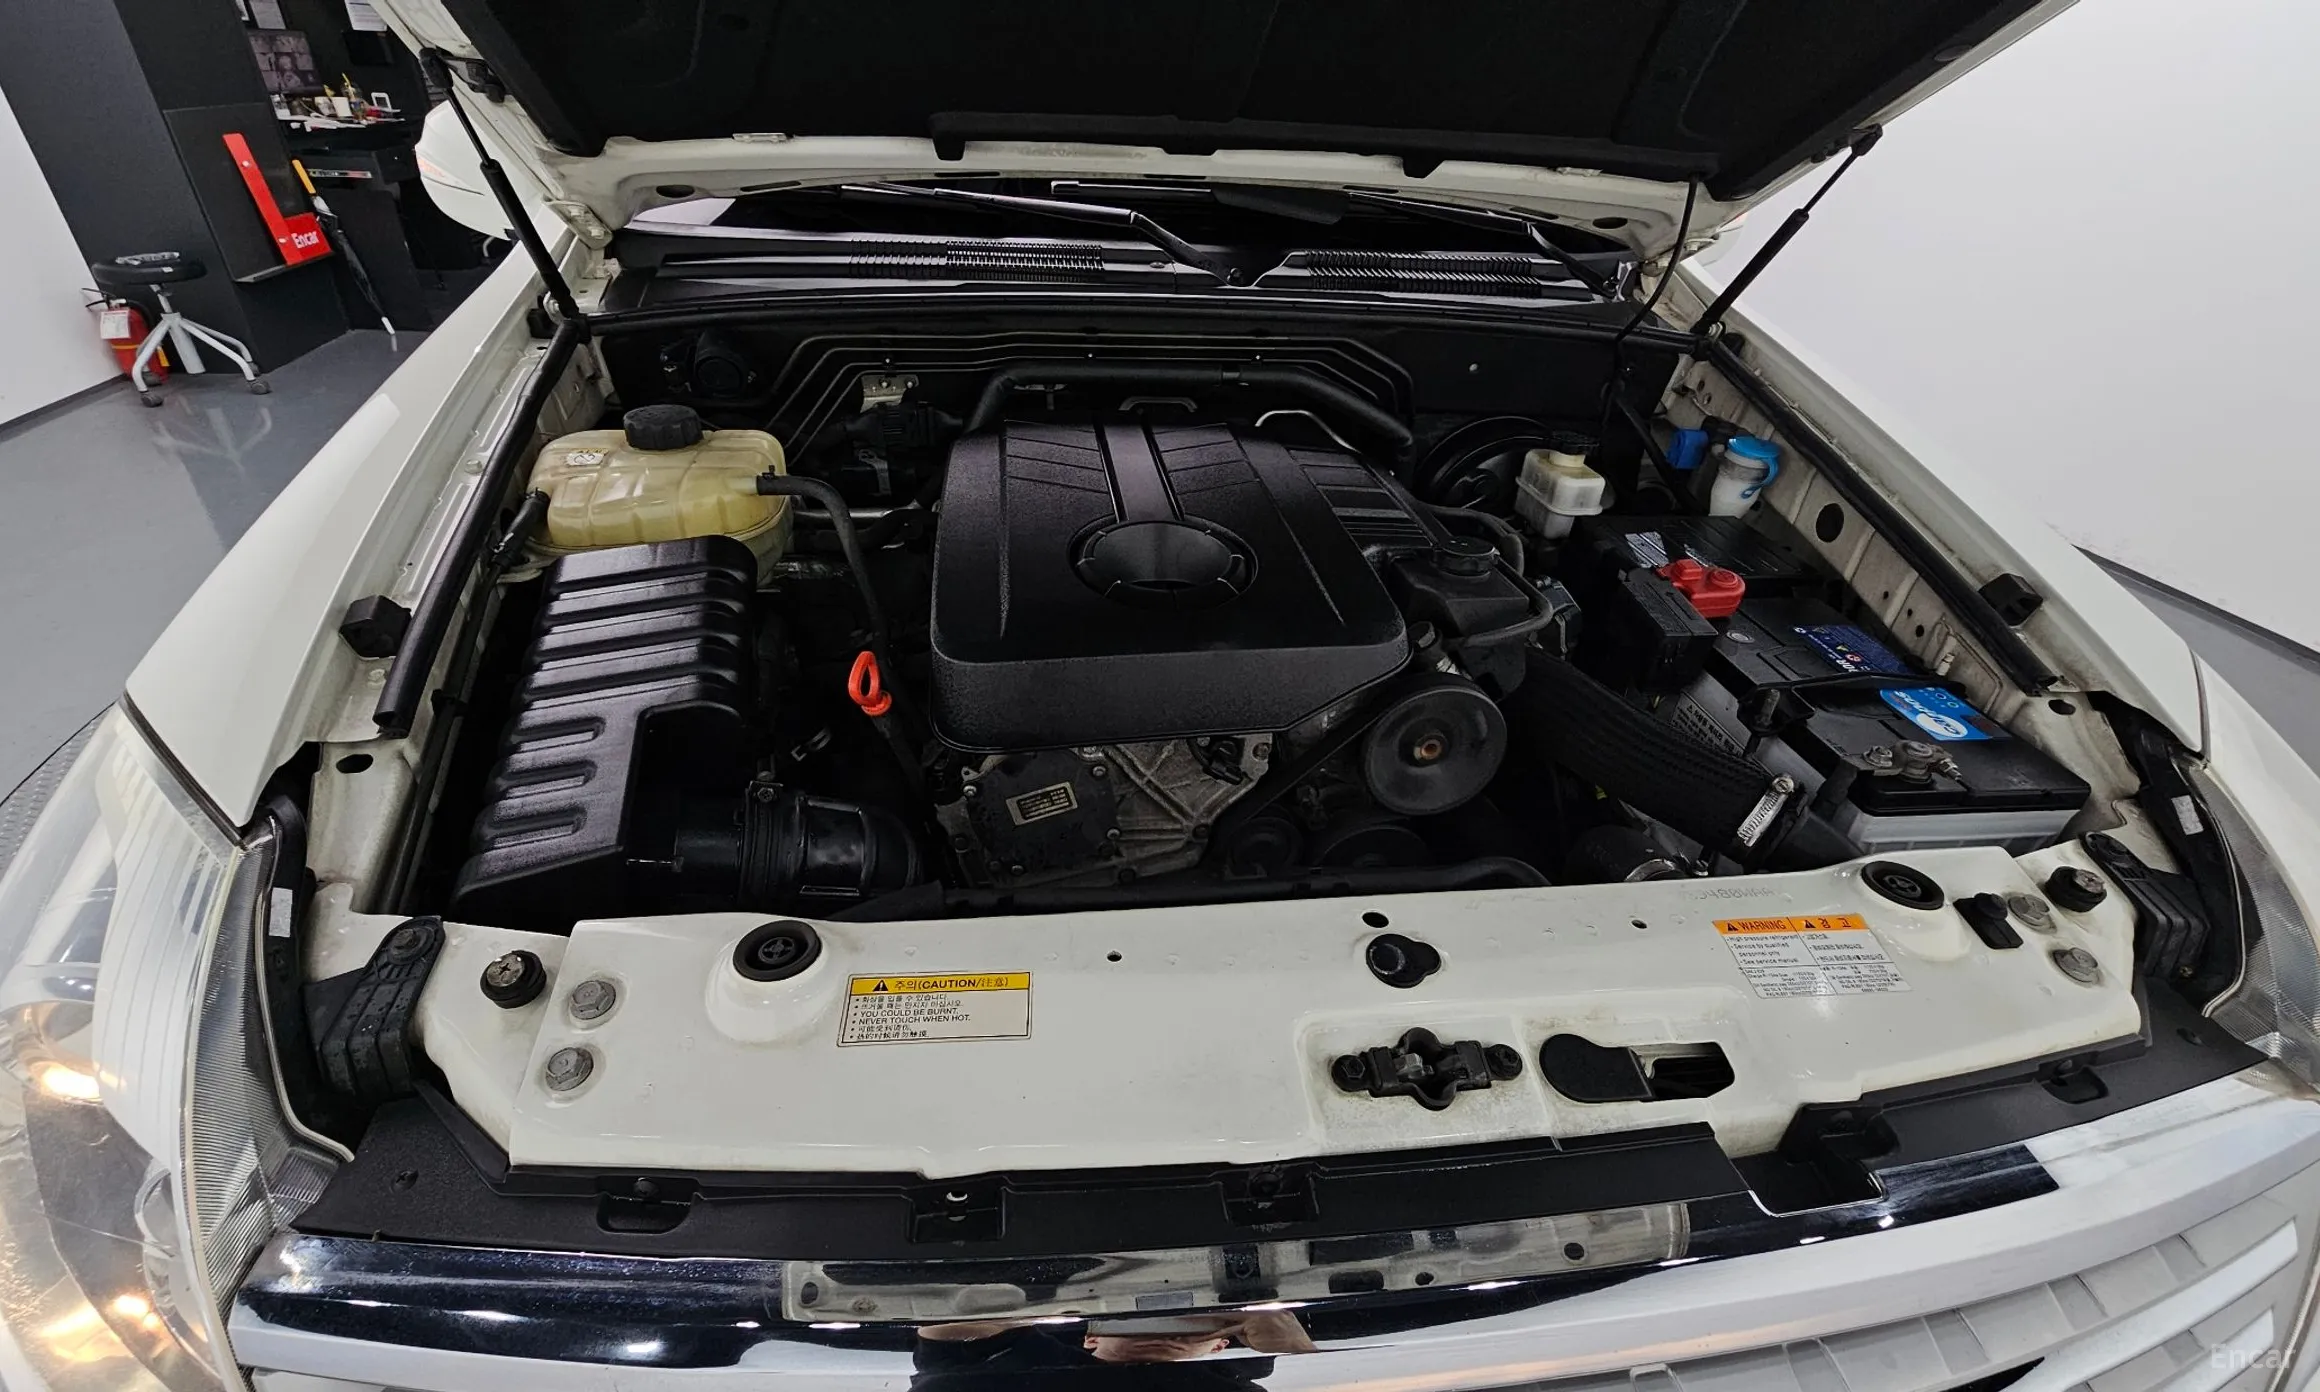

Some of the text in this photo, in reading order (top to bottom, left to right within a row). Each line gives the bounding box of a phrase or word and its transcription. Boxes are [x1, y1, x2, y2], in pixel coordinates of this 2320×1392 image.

[290, 231, 319, 249] Encar
[1738, 919, 1787, 932] WARNING
[860, 1007, 959, 1018] YOU COULD BE BURNT.
[858, 1014, 971, 1025] NEVER TOUCH WHEN HOT.
